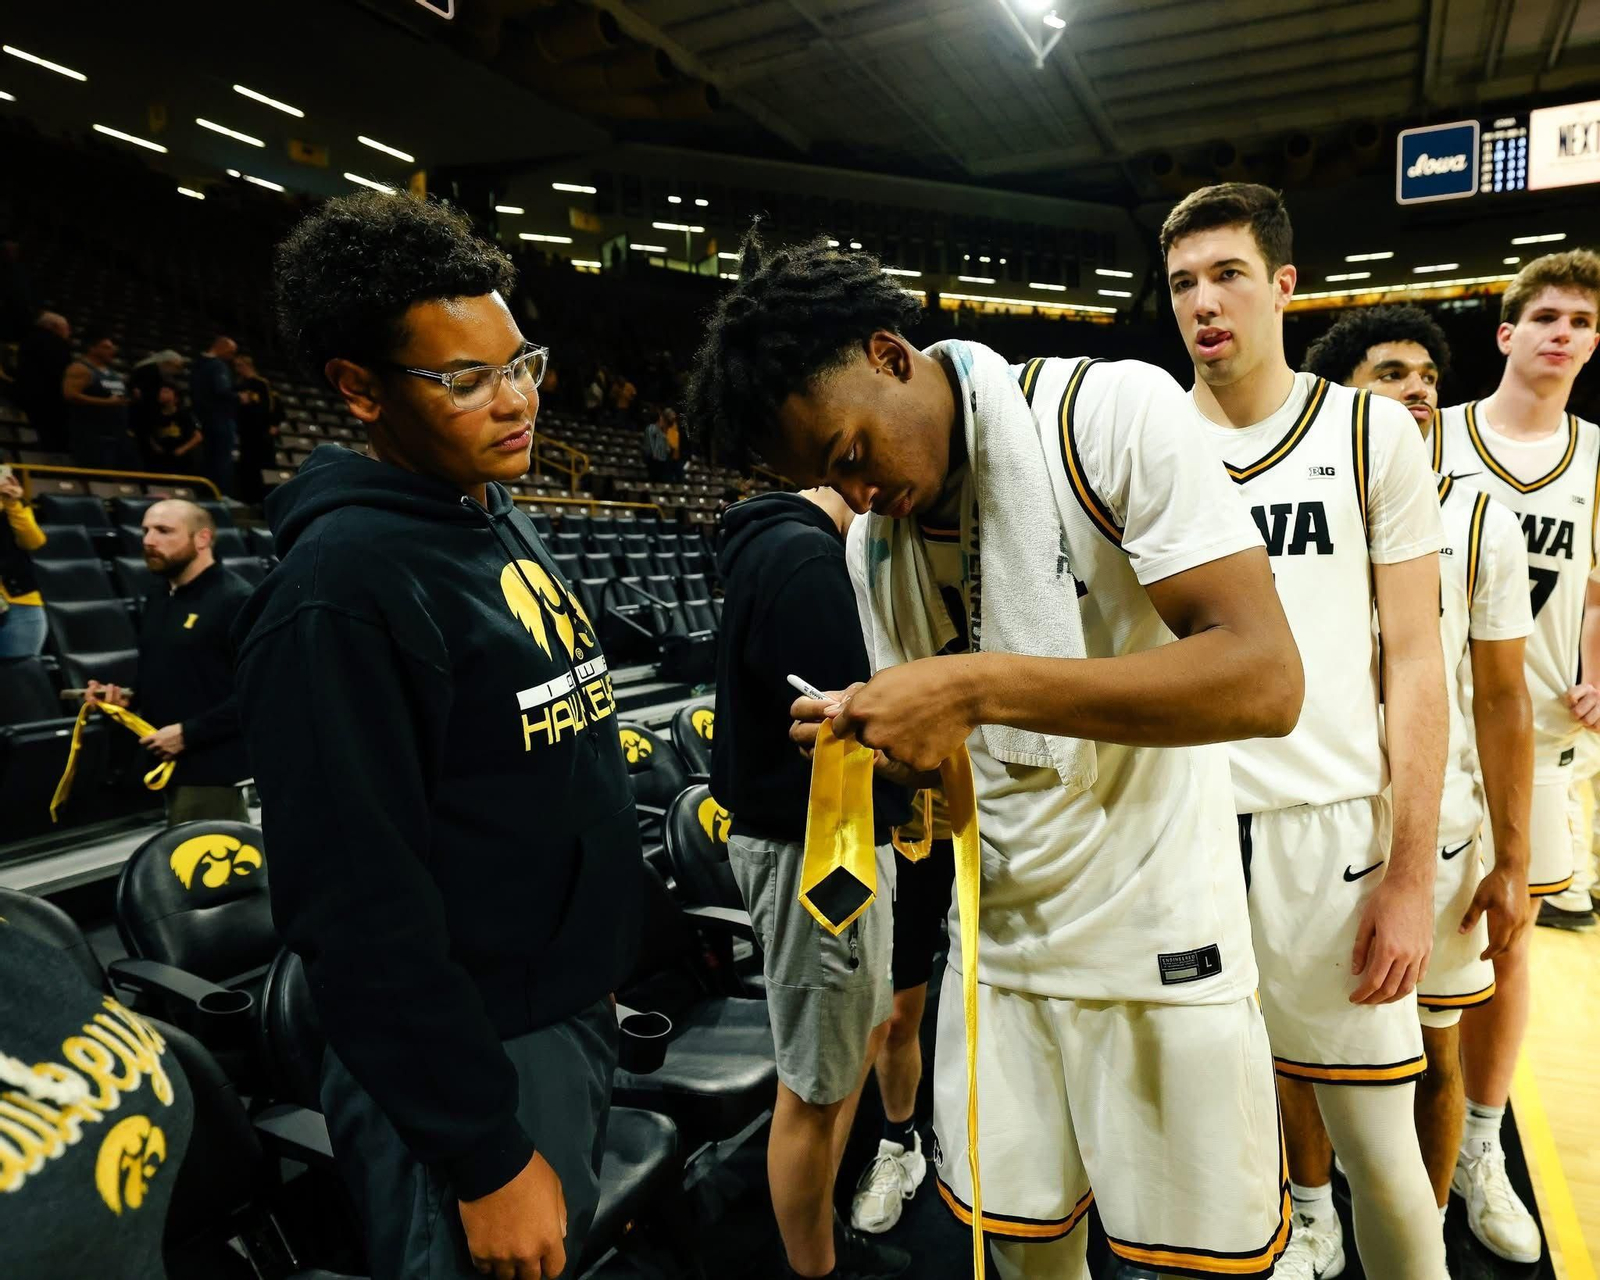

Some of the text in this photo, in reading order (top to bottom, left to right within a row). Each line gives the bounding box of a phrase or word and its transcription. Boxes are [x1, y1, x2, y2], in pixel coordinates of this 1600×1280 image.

[1407, 153, 1467, 178] Iowa
[1513, 511, 1574, 560] WA
[1205, 956, 1213, 968] L
